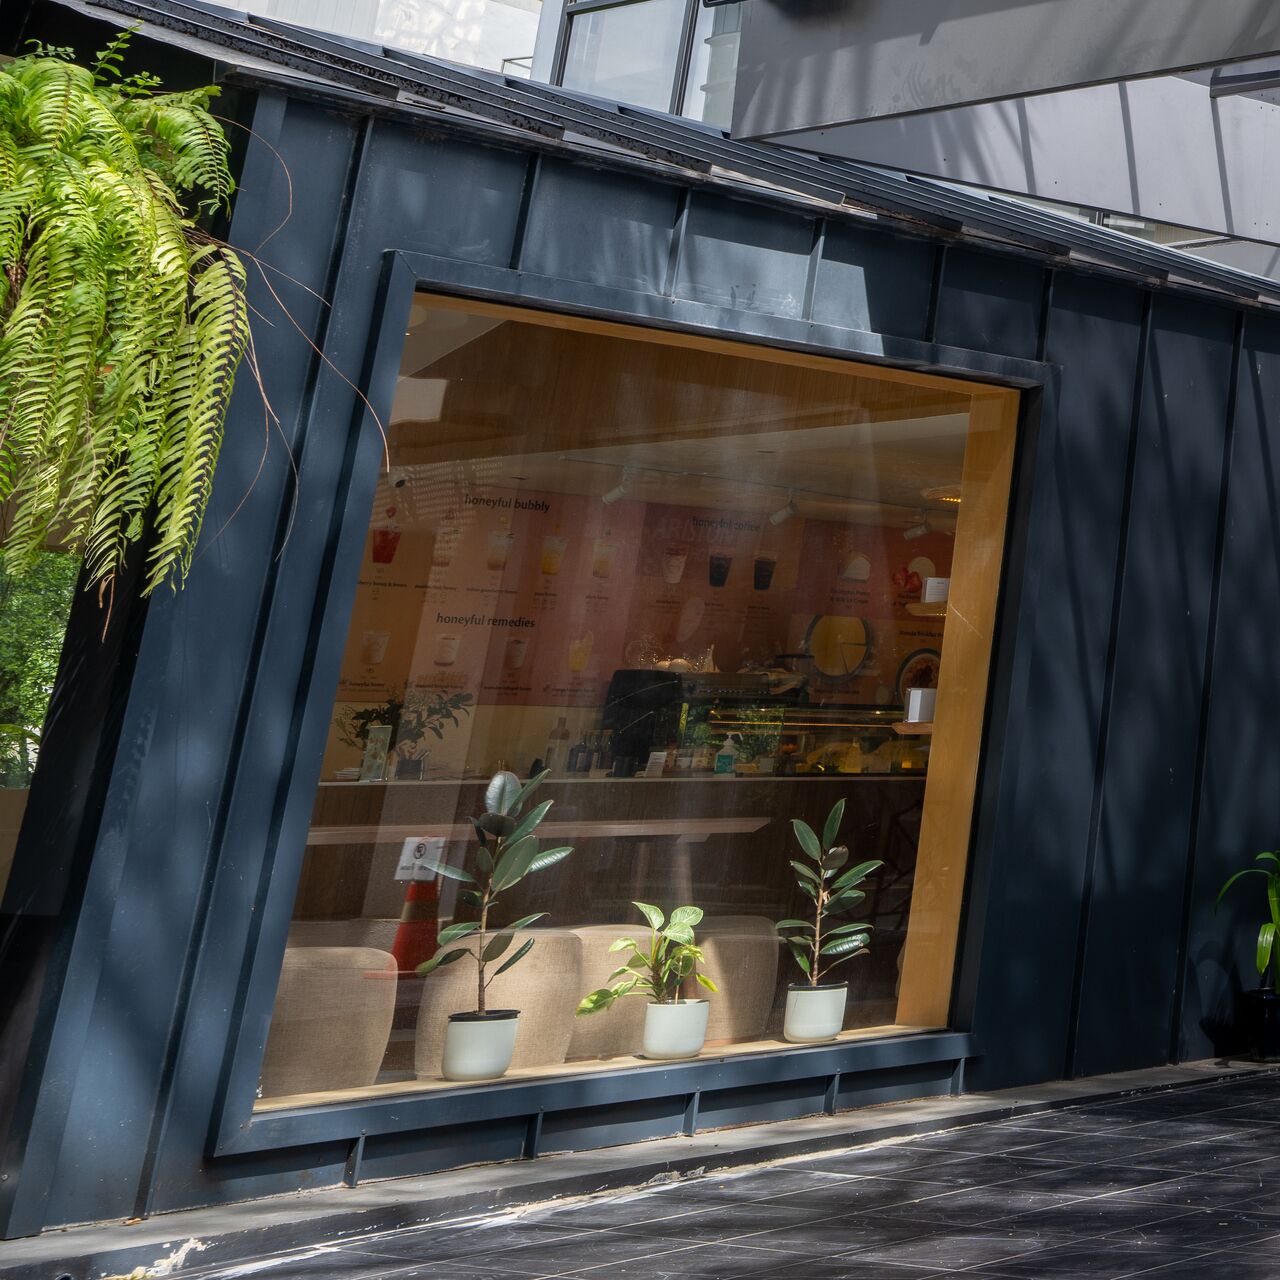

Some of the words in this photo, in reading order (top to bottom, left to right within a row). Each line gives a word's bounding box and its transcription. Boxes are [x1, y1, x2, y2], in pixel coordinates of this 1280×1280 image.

[464, 494, 512, 509] honeyful
[514, 498, 551, 514] bubbly
[436, 612, 485, 627] honeyful
[487, 616, 535, 628] remedies
